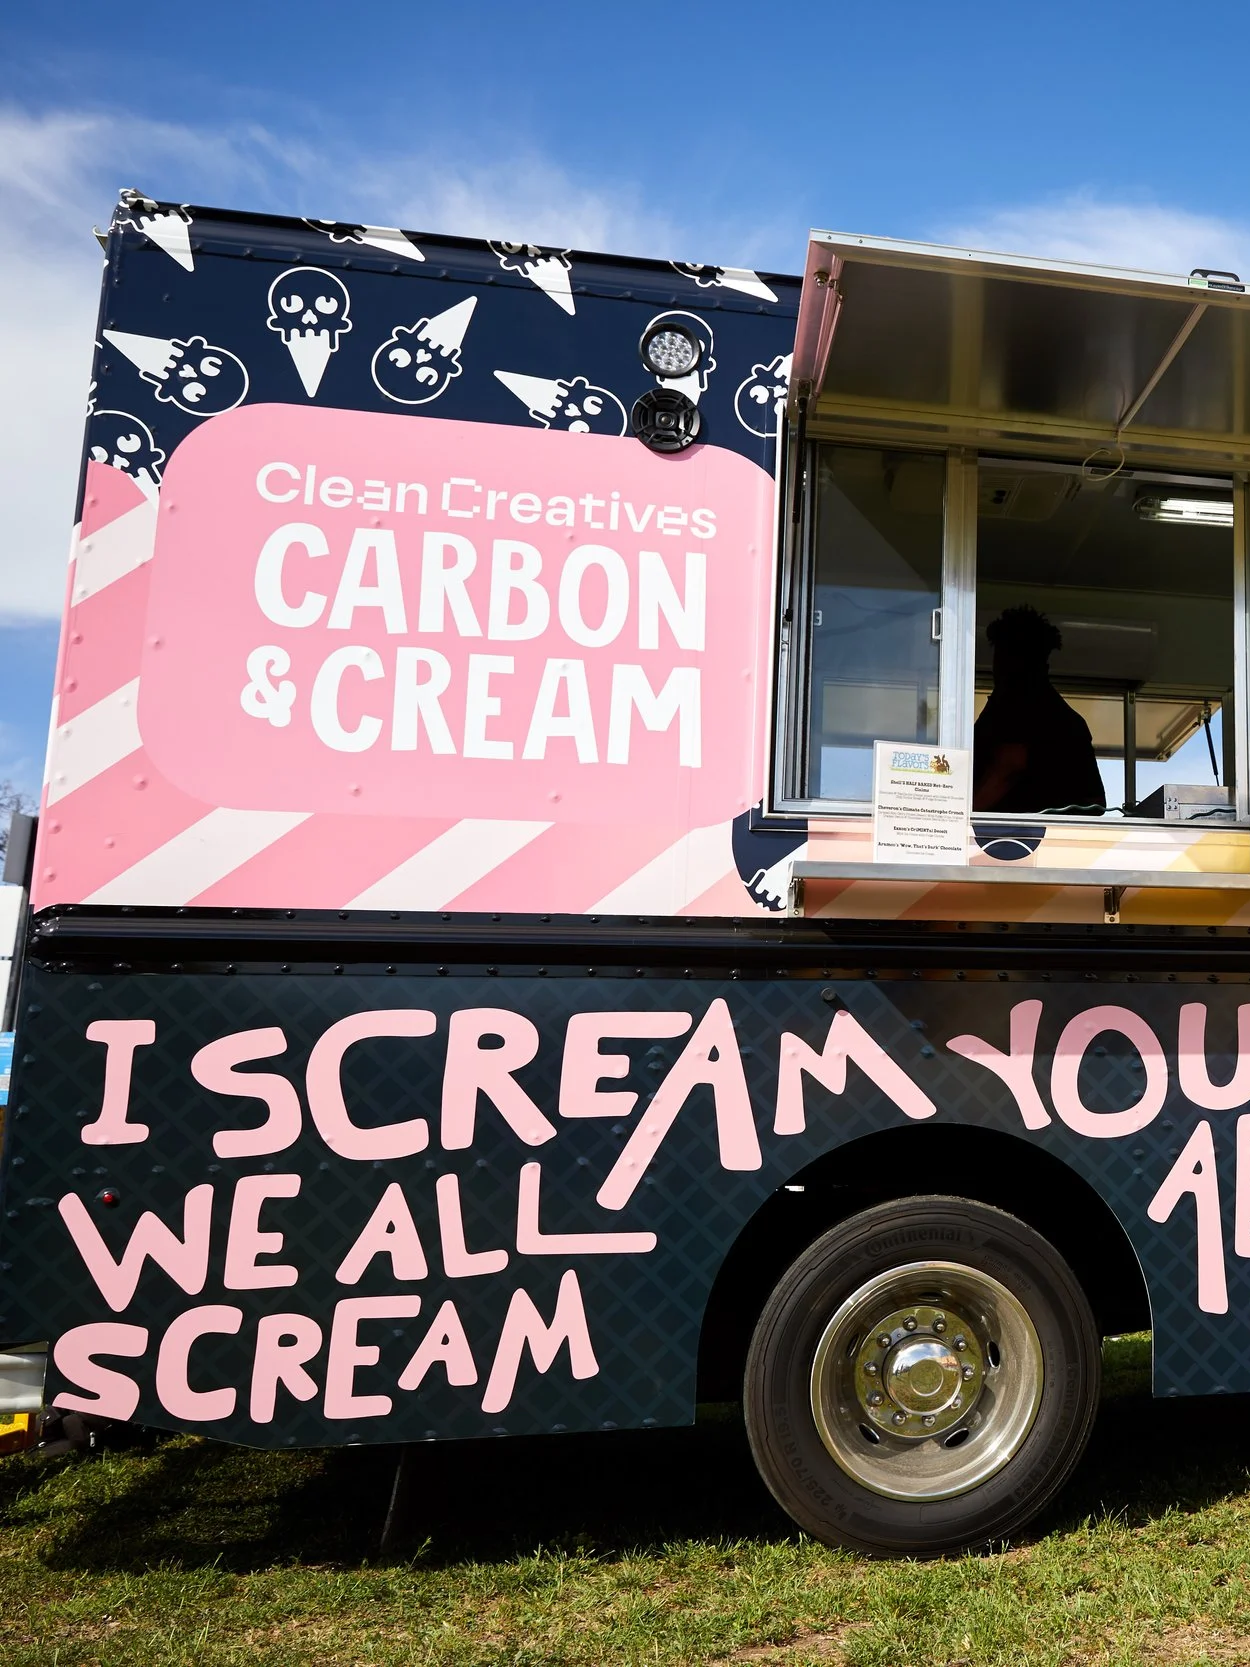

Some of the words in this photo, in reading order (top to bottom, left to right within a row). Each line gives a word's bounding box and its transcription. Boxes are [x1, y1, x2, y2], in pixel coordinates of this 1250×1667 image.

[255, 461, 427, 515] Clean
[441, 477, 717, 540] Creatives
[254, 522, 706, 652] CARBON
[81, 1019, 156, 1146] I
[191, 997, 937, 1210] SCREAM
[57, 1173, 302, 1312] WE
[335, 1161, 657, 1286] ALL
[52, 1268, 600, 1424] SCREAM
